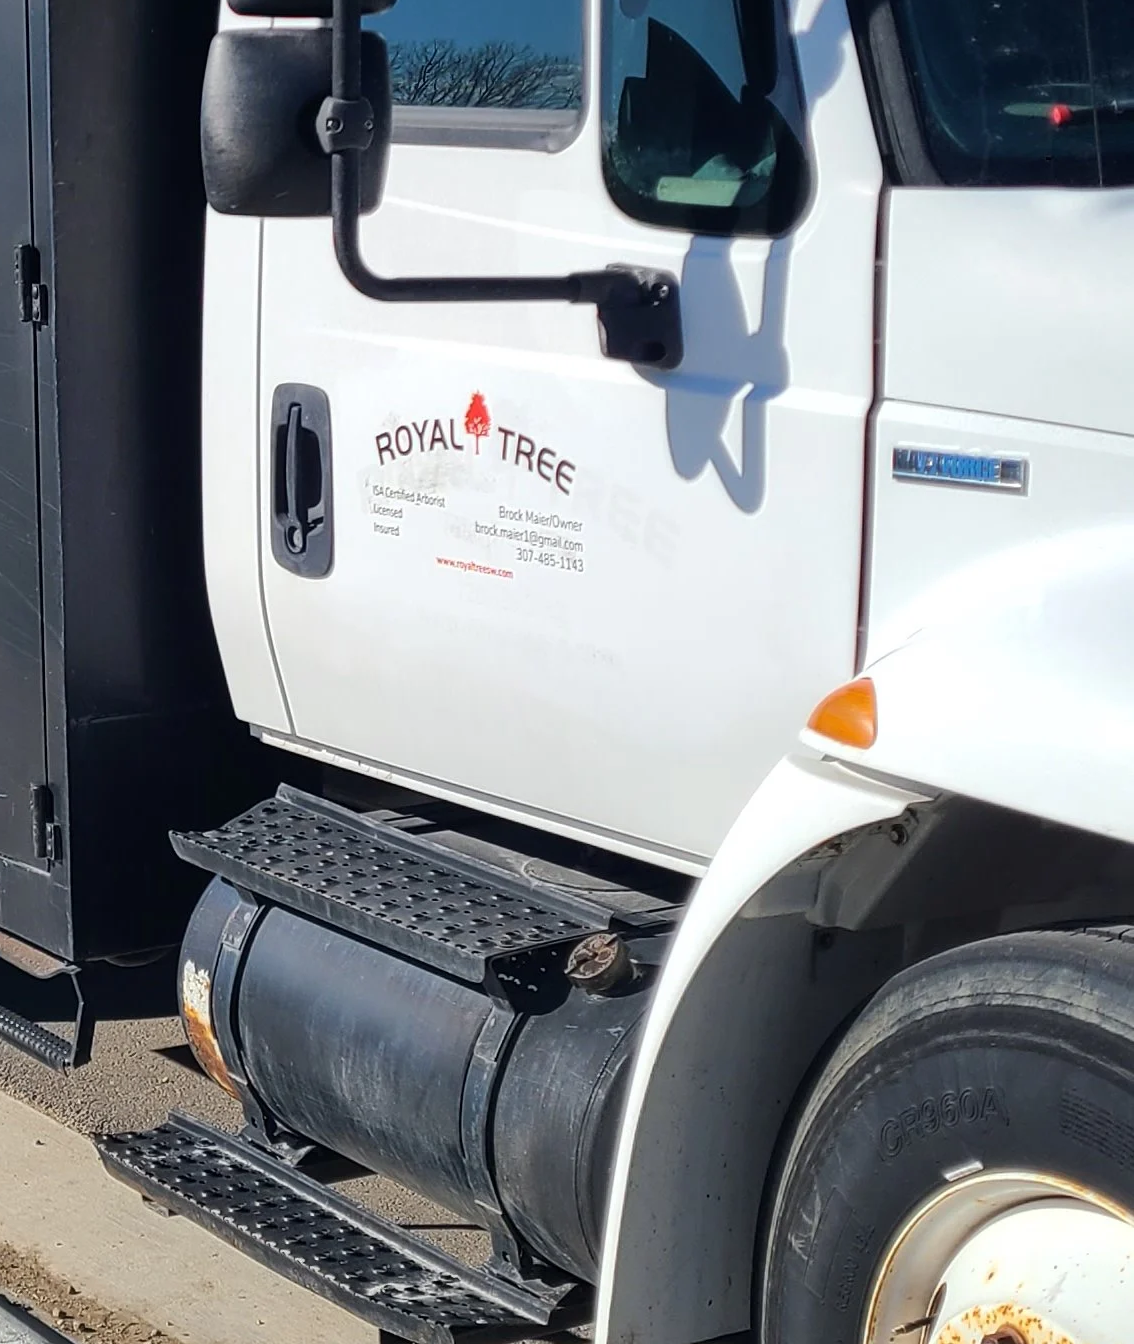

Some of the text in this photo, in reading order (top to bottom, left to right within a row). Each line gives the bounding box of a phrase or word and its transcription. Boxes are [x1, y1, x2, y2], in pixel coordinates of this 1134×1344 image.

[375, 418, 576, 495] ROYAL TREE
[373, 485, 446, 508] ISA Certified Arborist
[373, 503, 403, 519] Licensed
[499, 506, 583, 532] Brock Maier/Owner
[373, 522, 400, 536] Insured
[475, 521, 584, 552] brock.maier1@gmail.com
[515, 547, 585, 573] 307-485-1143
[878, 1086, 1008, 1158] CR960A
